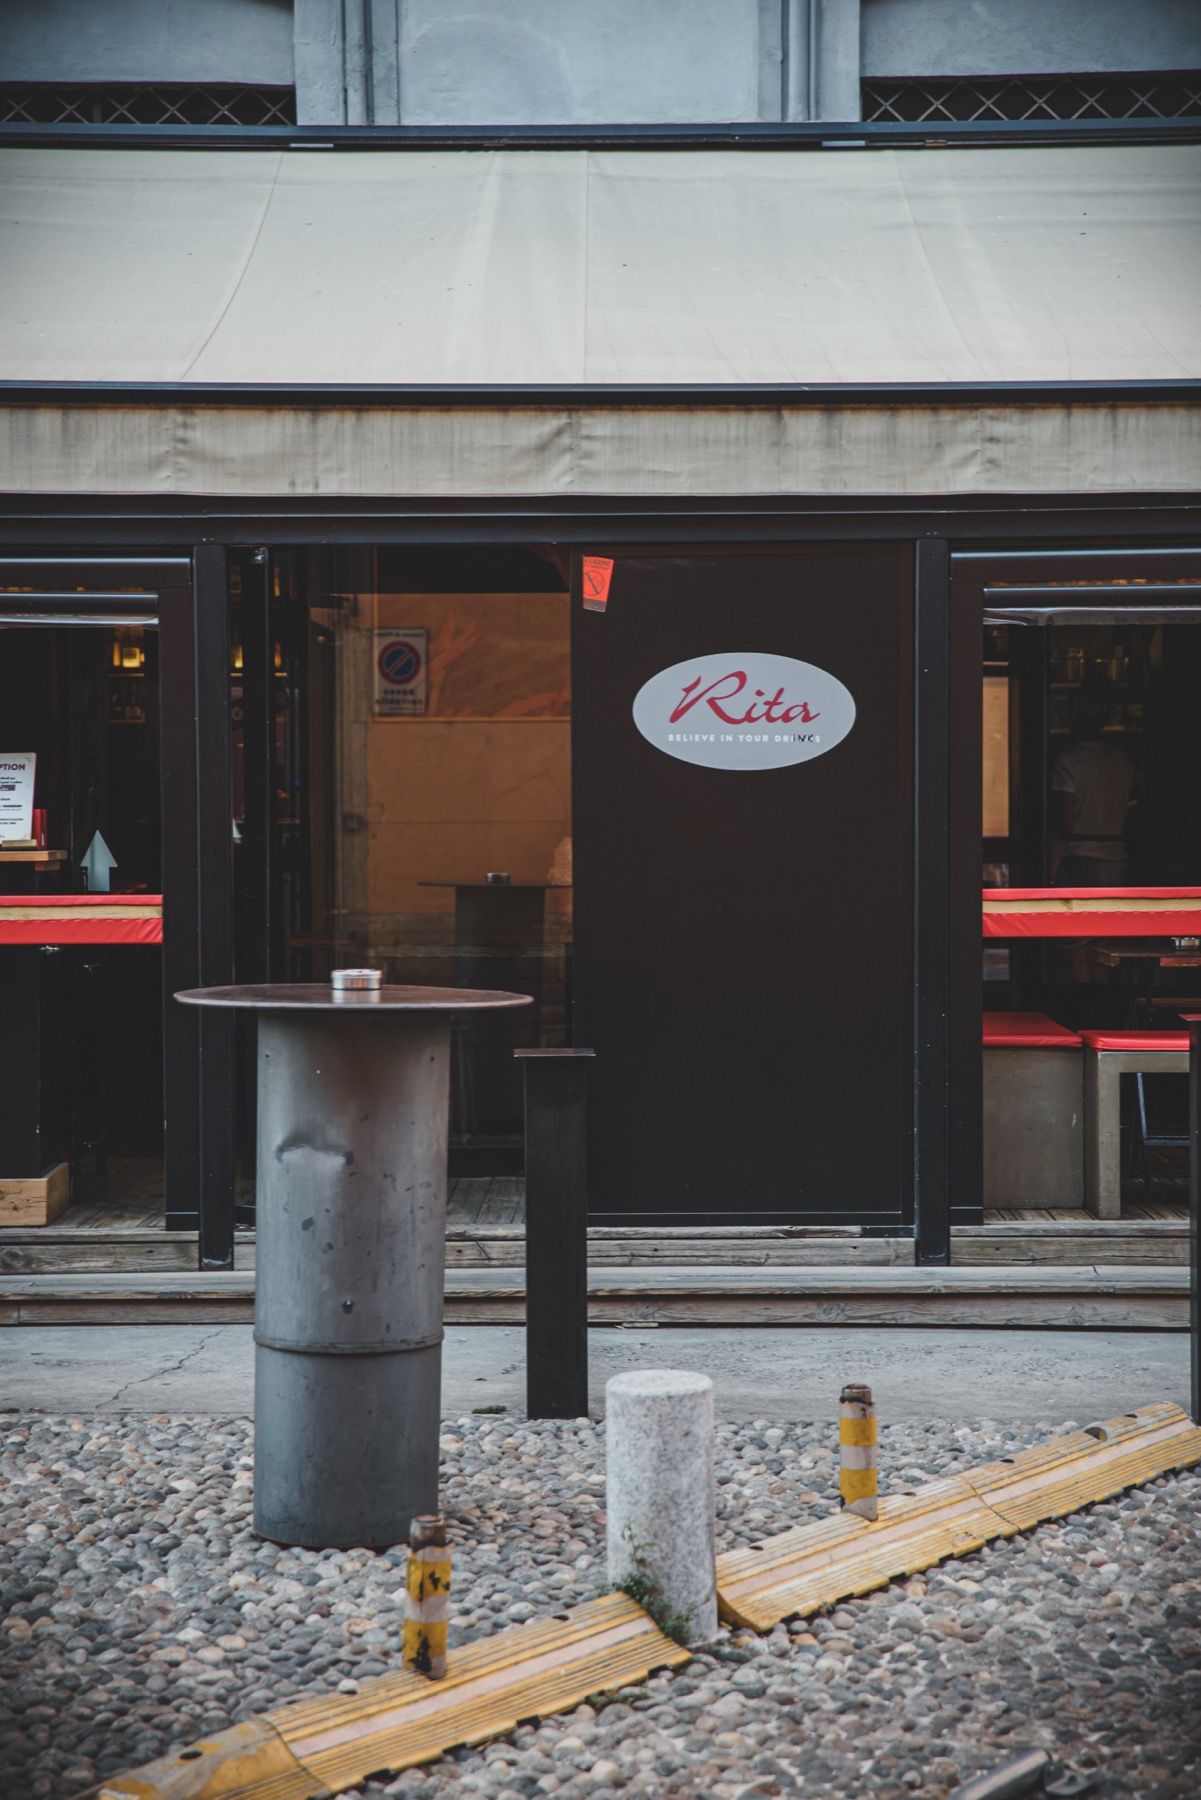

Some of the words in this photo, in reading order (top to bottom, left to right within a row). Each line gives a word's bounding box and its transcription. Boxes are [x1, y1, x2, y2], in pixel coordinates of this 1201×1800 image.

[669, 671, 820, 725] Rita
[668, 734, 715, 742] BELIEVE
[720, 734, 733, 742] IN
[738, 734, 769, 742] YOUR
